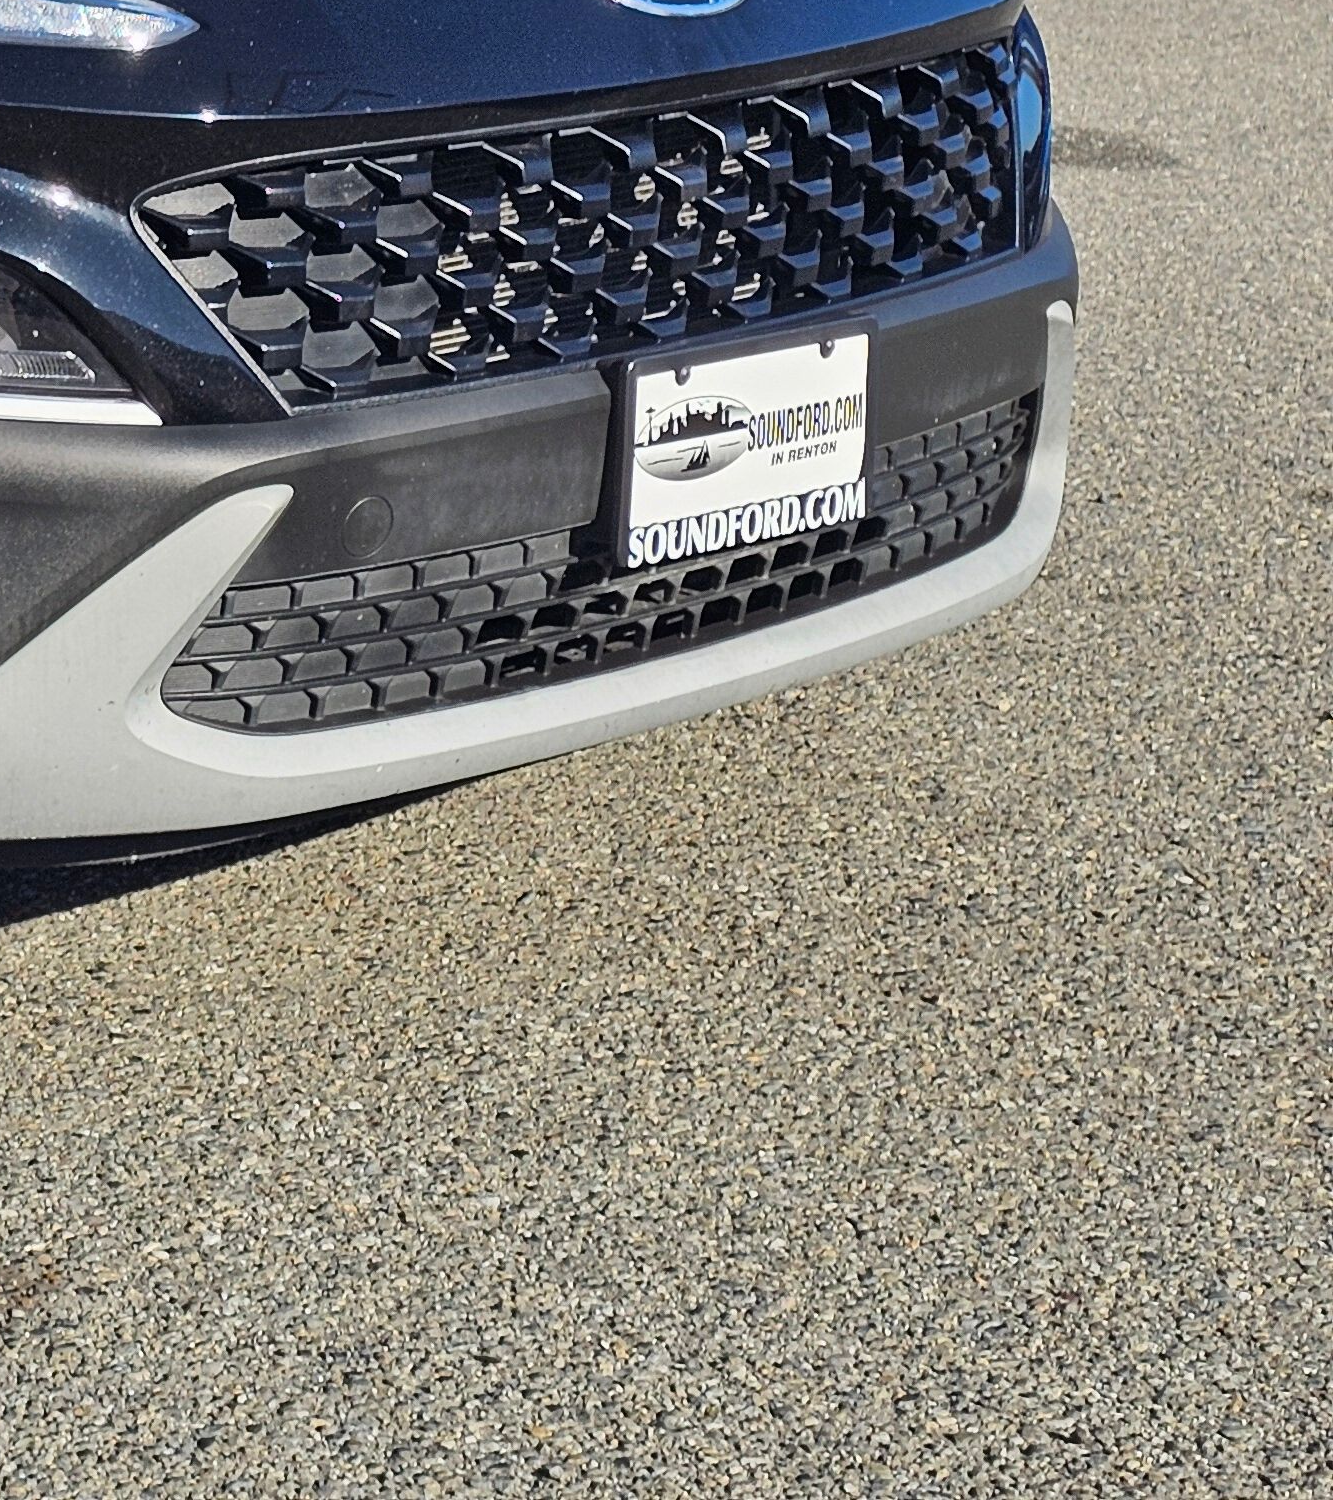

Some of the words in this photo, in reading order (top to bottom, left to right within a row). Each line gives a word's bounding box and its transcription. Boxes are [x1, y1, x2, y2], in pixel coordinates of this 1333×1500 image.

[747, 392, 863, 451] SOUNDFORD.COM
[771, 451, 784, 467] IN
[787, 440, 838, 464] RENTON
[627, 476, 866, 569] SOUNDFORD.COM
